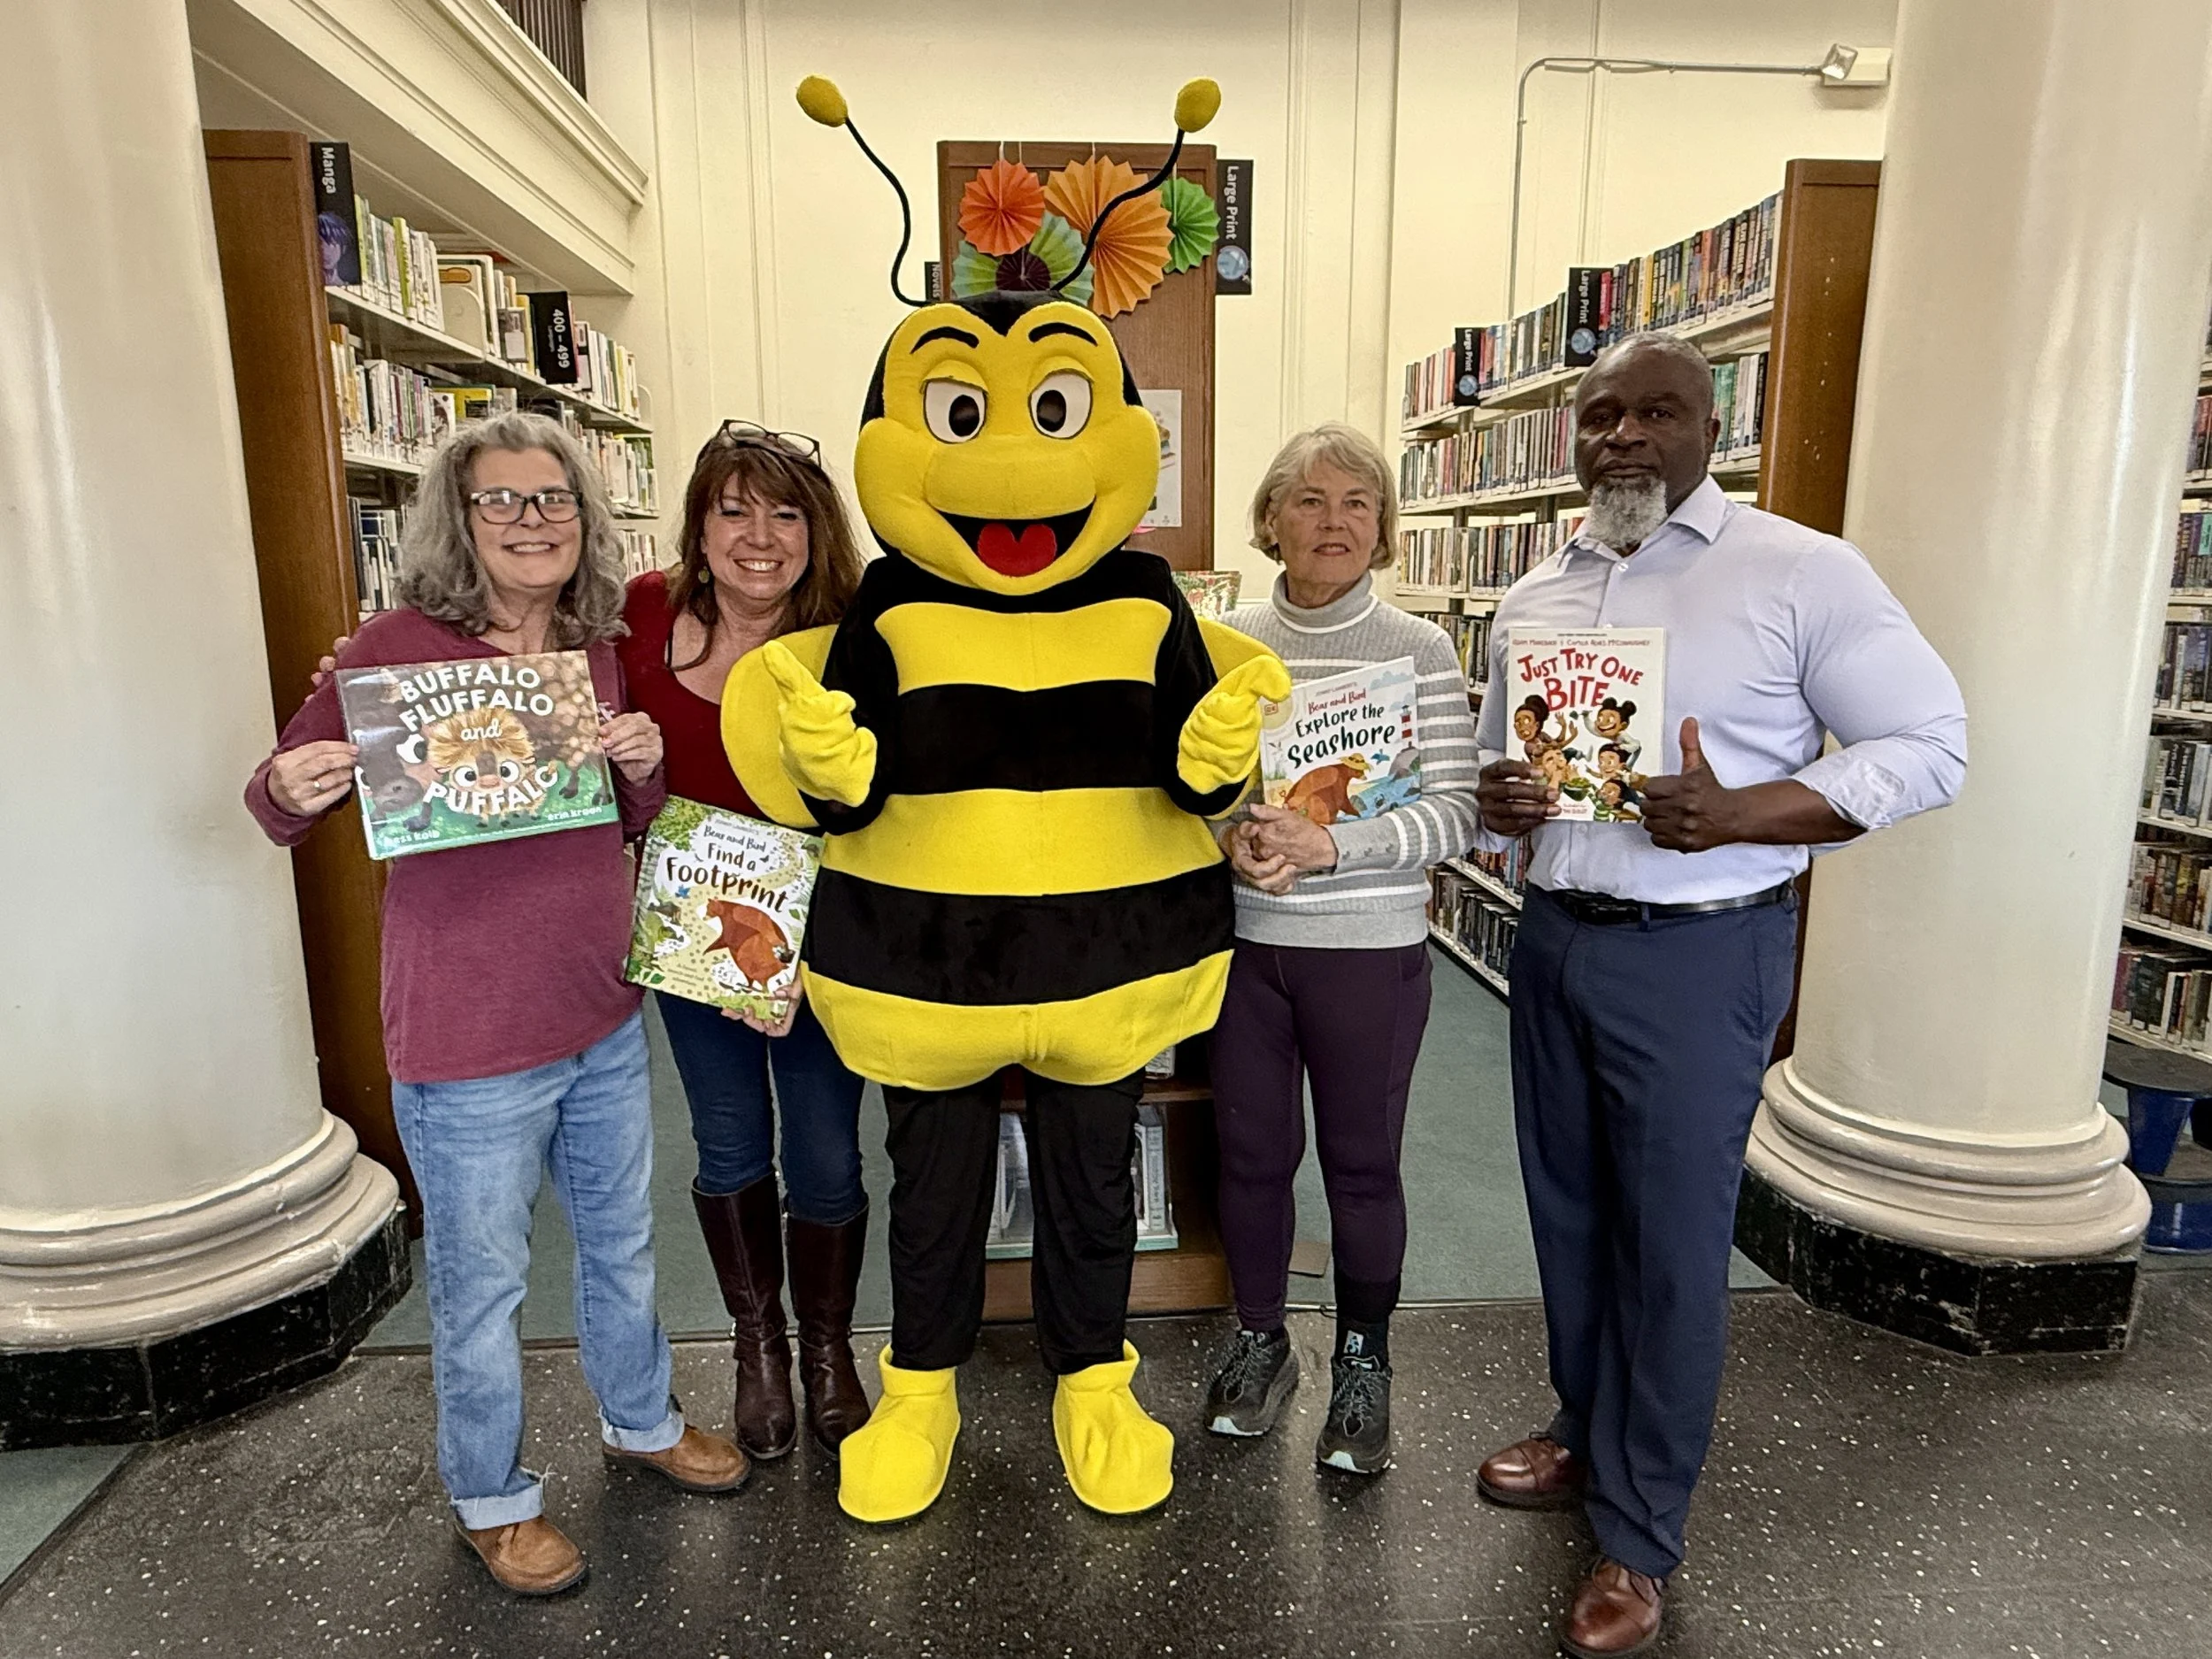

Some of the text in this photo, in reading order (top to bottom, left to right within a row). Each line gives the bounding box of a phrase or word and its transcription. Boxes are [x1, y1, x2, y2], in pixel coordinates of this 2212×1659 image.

[321, 147, 336, 194] Manga
[1224, 165, 1239, 240] Large Print
[1578, 270, 1591, 324] Large Print
[552, 308, 566, 333] 400
[557, 344, 571, 369] 499
[1463, 328, 1473, 372] Large Print
[399, 664, 541, 703] BUFFALO
[1517, 648, 1644, 686] JUST TRY ONE
[398, 688, 554, 733] FLUFFALO
[1308, 702, 1328, 715] Bear
[1330, 694, 1347, 706] and
[1348, 687, 1366, 703] Bird
[1544, 675, 1610, 712] BITE
[460, 718, 503, 741] and
[1295, 708, 1357, 738] Explore
[1362, 703, 1385, 720] the
[1287, 725, 1395, 769] Seashore
[423, 765, 558, 815] PUFFALO
[703, 825, 725, 840] Bear
[726, 836, 745, 846] and
[707, 842, 757, 872] Find a
[666, 856, 788, 913] Footprint
